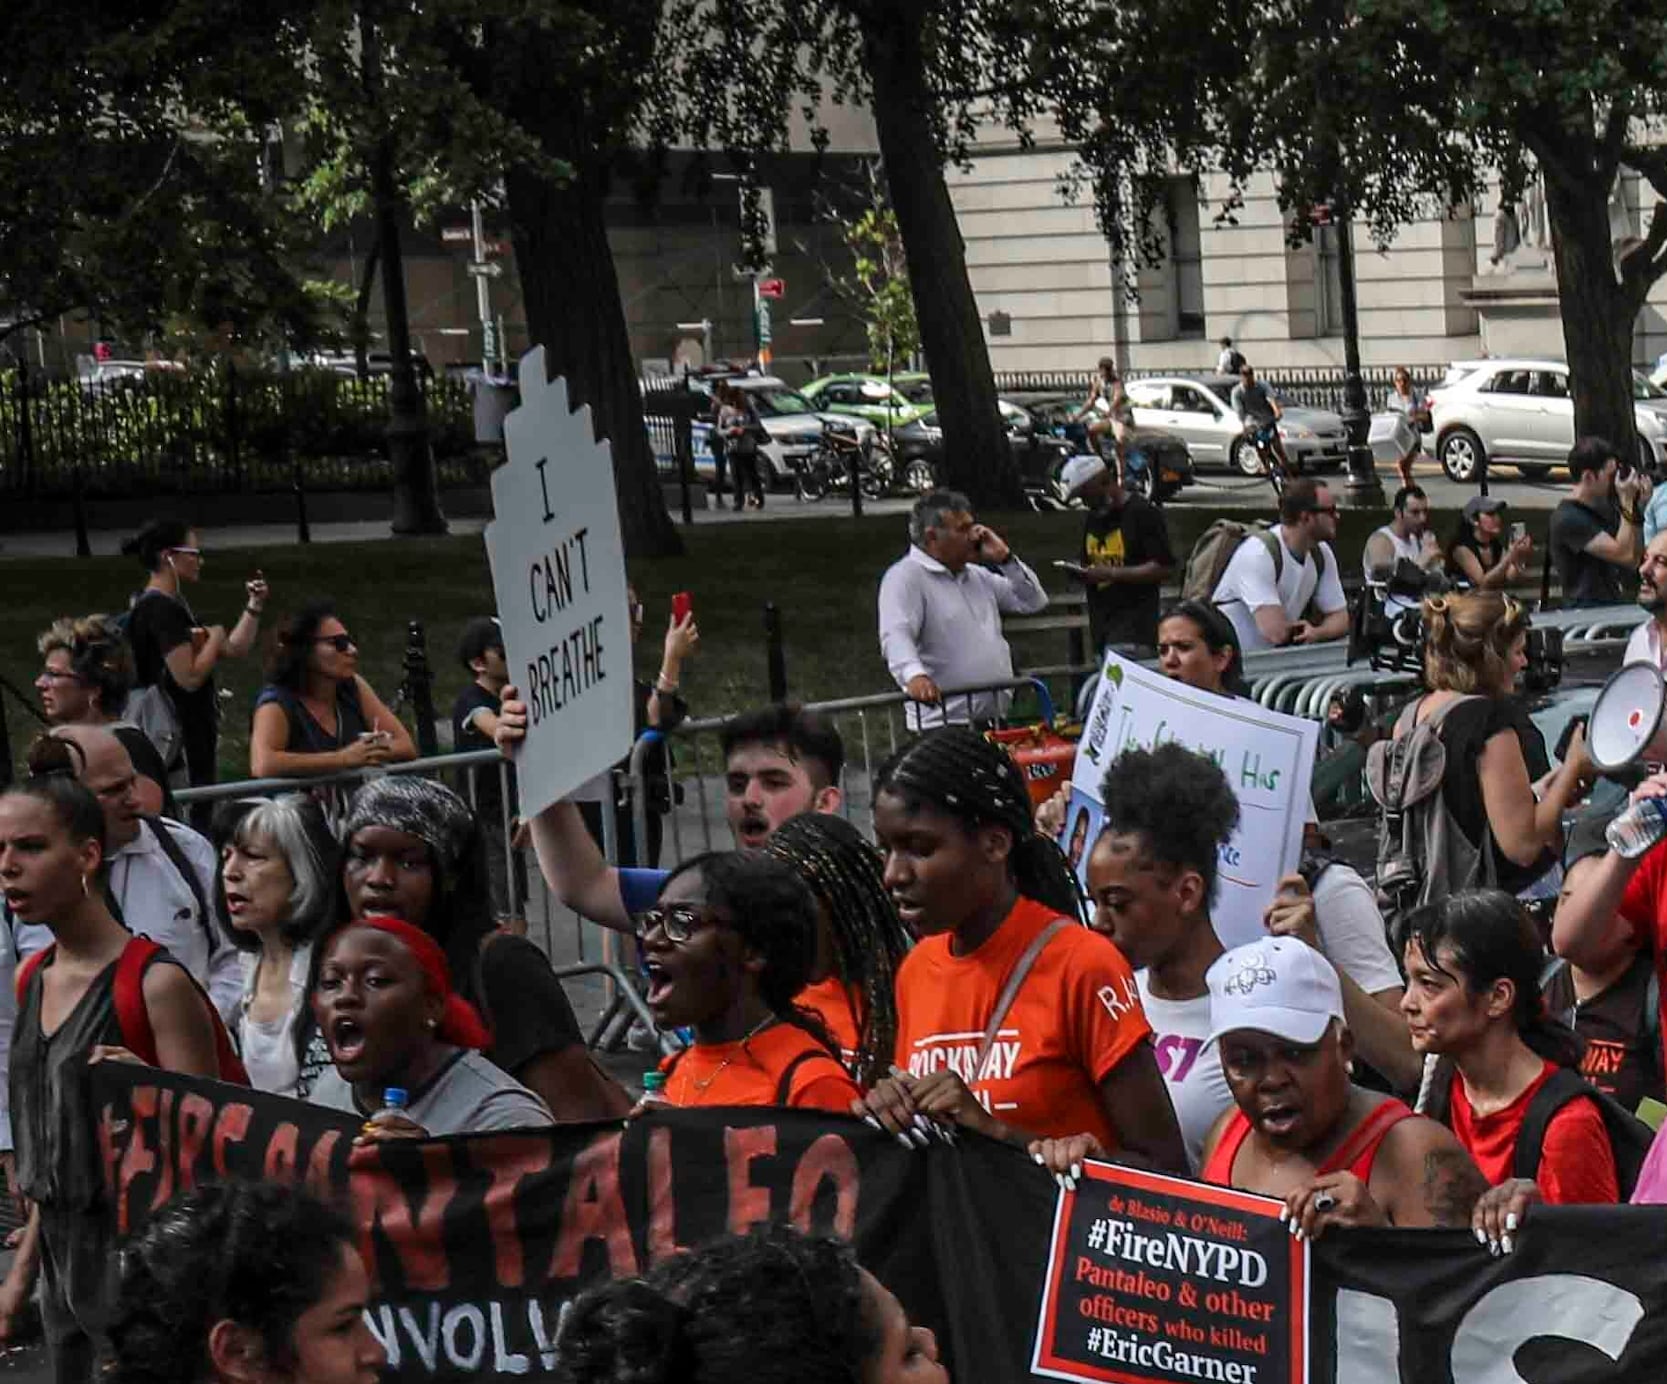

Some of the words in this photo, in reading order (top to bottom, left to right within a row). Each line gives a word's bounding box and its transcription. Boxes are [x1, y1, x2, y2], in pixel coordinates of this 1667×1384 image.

[535, 457, 555, 523] I
[528, 527, 590, 624] CAN'T
[527, 615, 607, 726] BREATHE
[1087, 1218, 1268, 1289] #FireNYPD
[1127, 1198, 1171, 1225] Blasio
[1175, 1212, 1187, 1228] &
[1191, 1212, 1248, 1242] O'Neill:
[1076, 1256, 1171, 1302] Pantaleo
[1178, 1281, 1198, 1309] &
[1205, 1291, 1276, 1323] other
[1079, 1294, 1159, 1334] officers
[1164, 1317, 1205, 1344] who
[1210, 1325, 1267, 1355] killed
